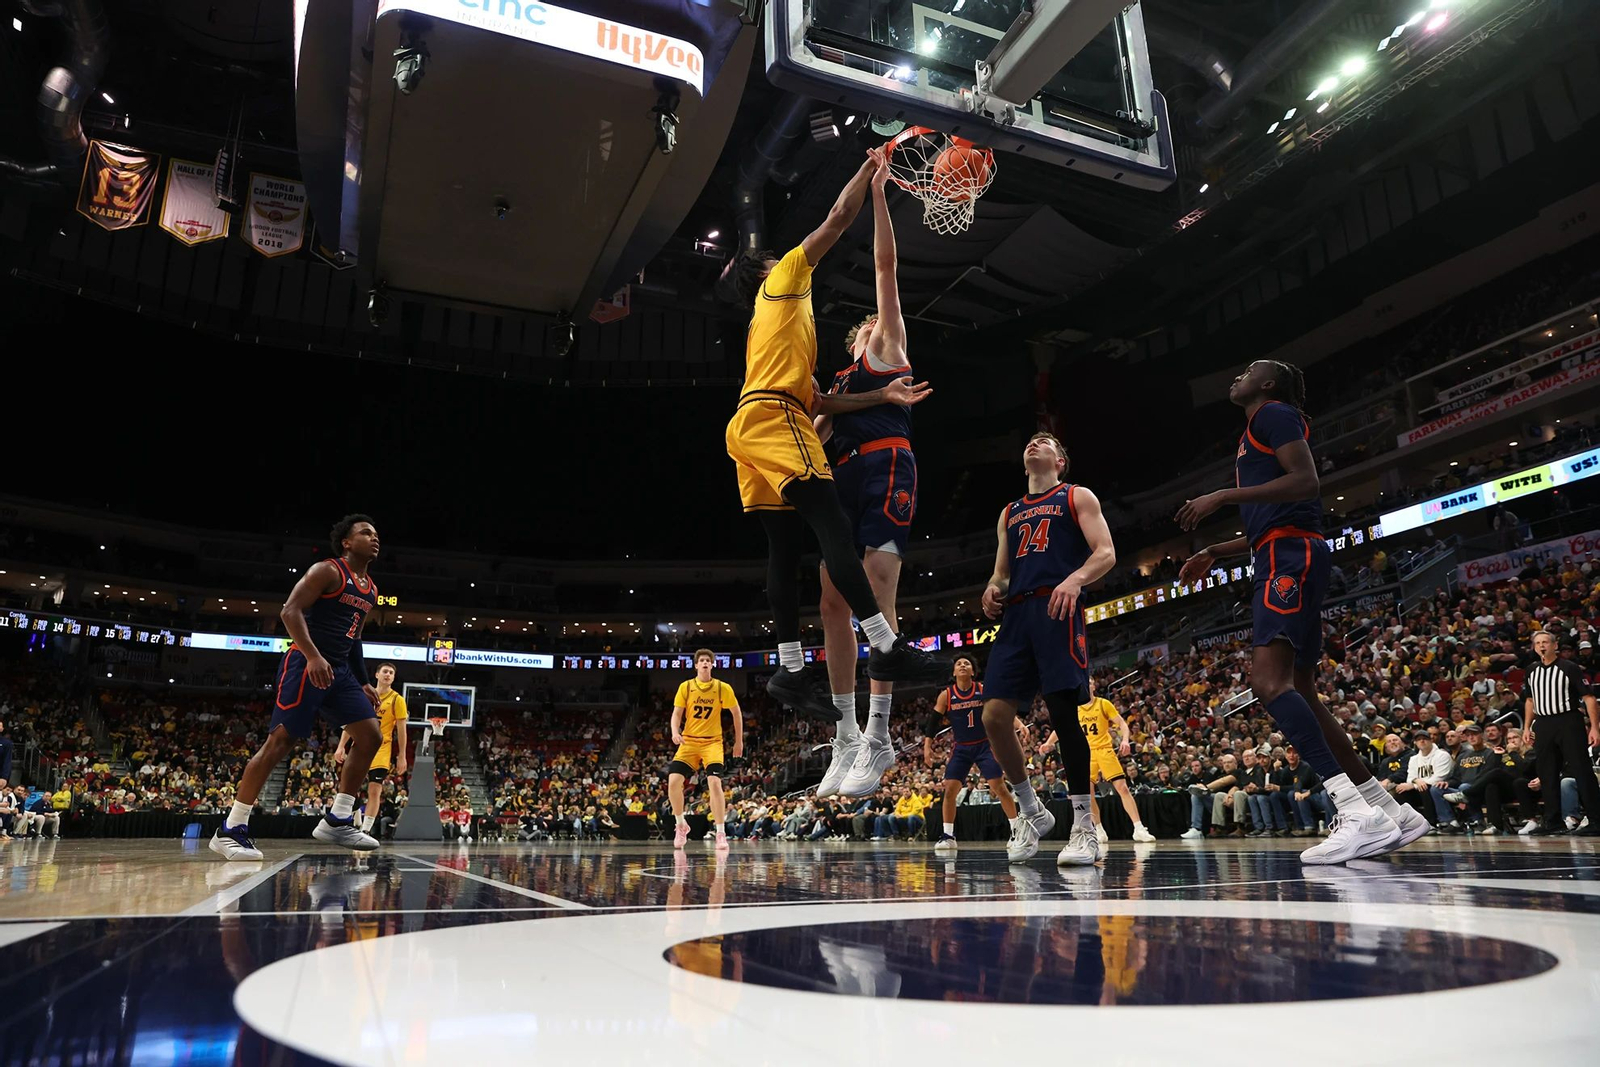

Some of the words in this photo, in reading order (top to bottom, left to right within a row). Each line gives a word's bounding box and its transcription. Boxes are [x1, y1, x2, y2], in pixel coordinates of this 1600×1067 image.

[177, 164, 195, 175] HALL
[196, 168, 206, 176] OF
[91, 167, 144, 210] 13
[266, 181, 295, 193] WORLD
[253, 188, 305, 203] CHAMPIONS
[87, 204, 139, 223] WARNER
[257, 238, 283, 249] 2018
[1504, 371, 1569, 408] FAREWAY
[1408, 412, 1463, 444] FAREWAY
[1425, 492, 1479, 515] UNBANK
[1500, 473, 1543, 491] WITH
[1570, 455, 1599, 474] US!
[1015, 518, 1051, 559] 24
[1335, 536, 1346, 551] 27
[1464, 561, 1511, 580] Coors
[377, 596, 398, 607] 8:48
[1356, 592, 1394, 606] MEDIACOM
[53, 622, 64, 633] 14
[105, 628, 116, 638] 15
[150, 634, 161, 644] 27
[693, 705, 713, 720] 27
[966, 709, 975, 728] 1
[1081, 723, 1099, 736] 14
